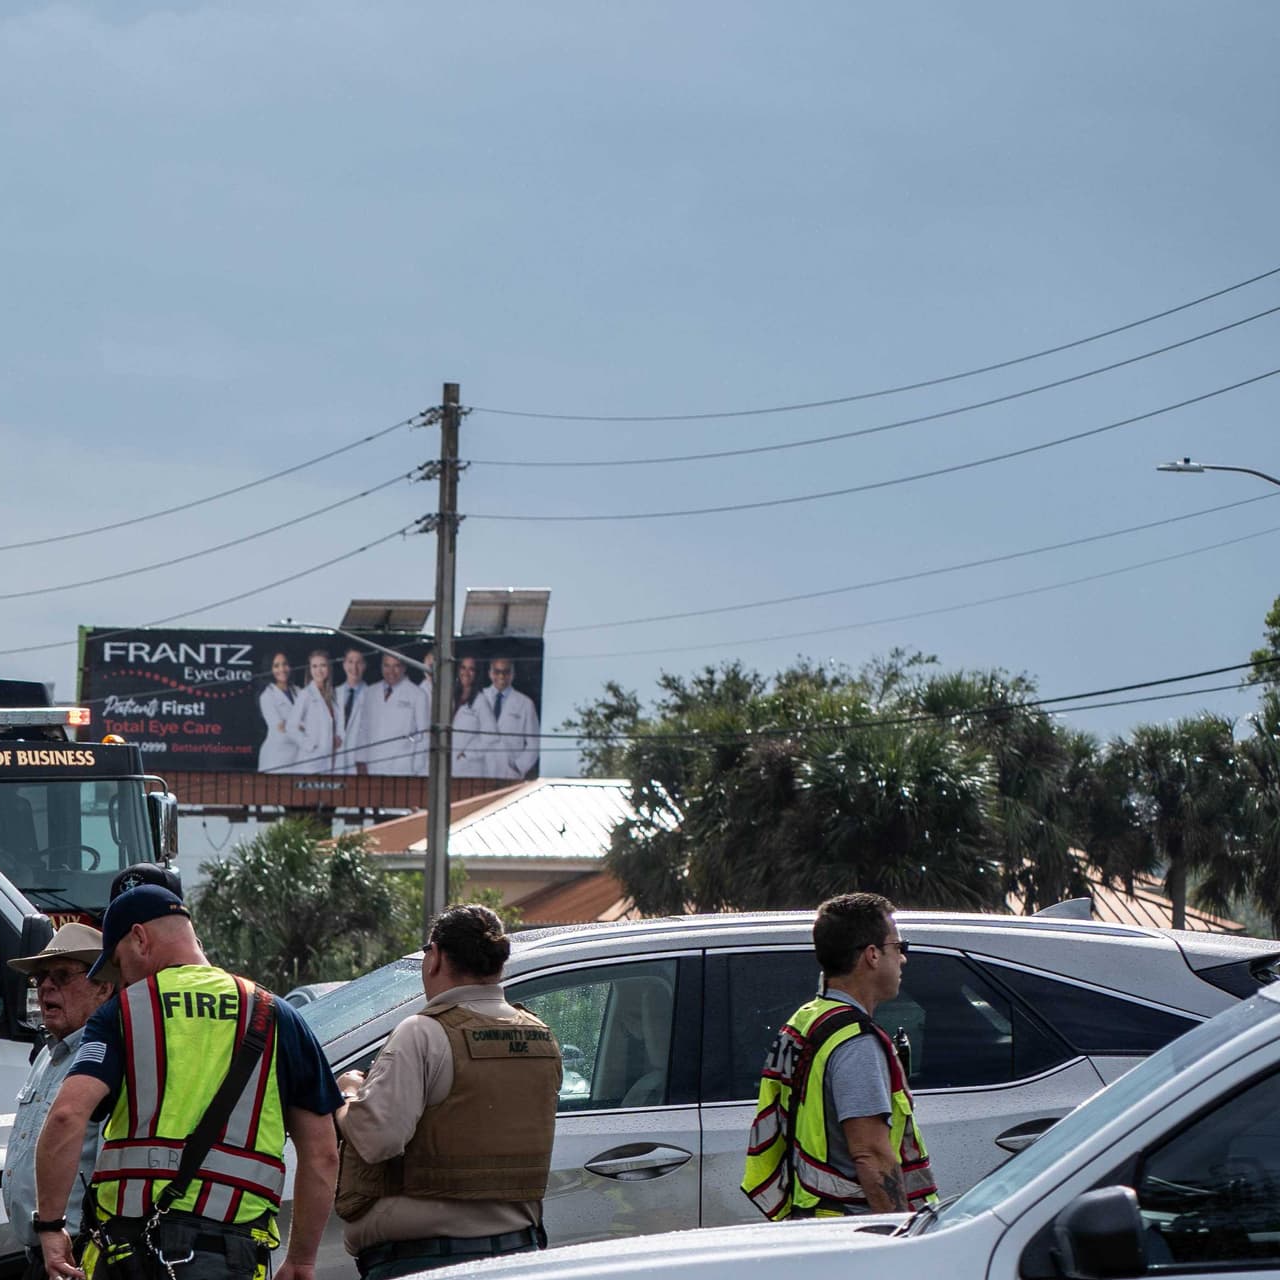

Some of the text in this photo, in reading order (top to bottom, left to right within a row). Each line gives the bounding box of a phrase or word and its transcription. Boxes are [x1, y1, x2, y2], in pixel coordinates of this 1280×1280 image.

[103, 642, 253, 665] FRANTZ
[184, 666, 253, 683] EyeCare
[161, 701, 206, 716] First!
[104, 720, 222, 736] Total Eye Care
[172, 742, 253, 754] BetterVision.net
[18, 750, 96, 766] BUSINESS
[50, 915, 80, 928] ANY
[162, 991, 239, 1020] FIRE
[472, 1029, 521, 1041] COMMUNITY
